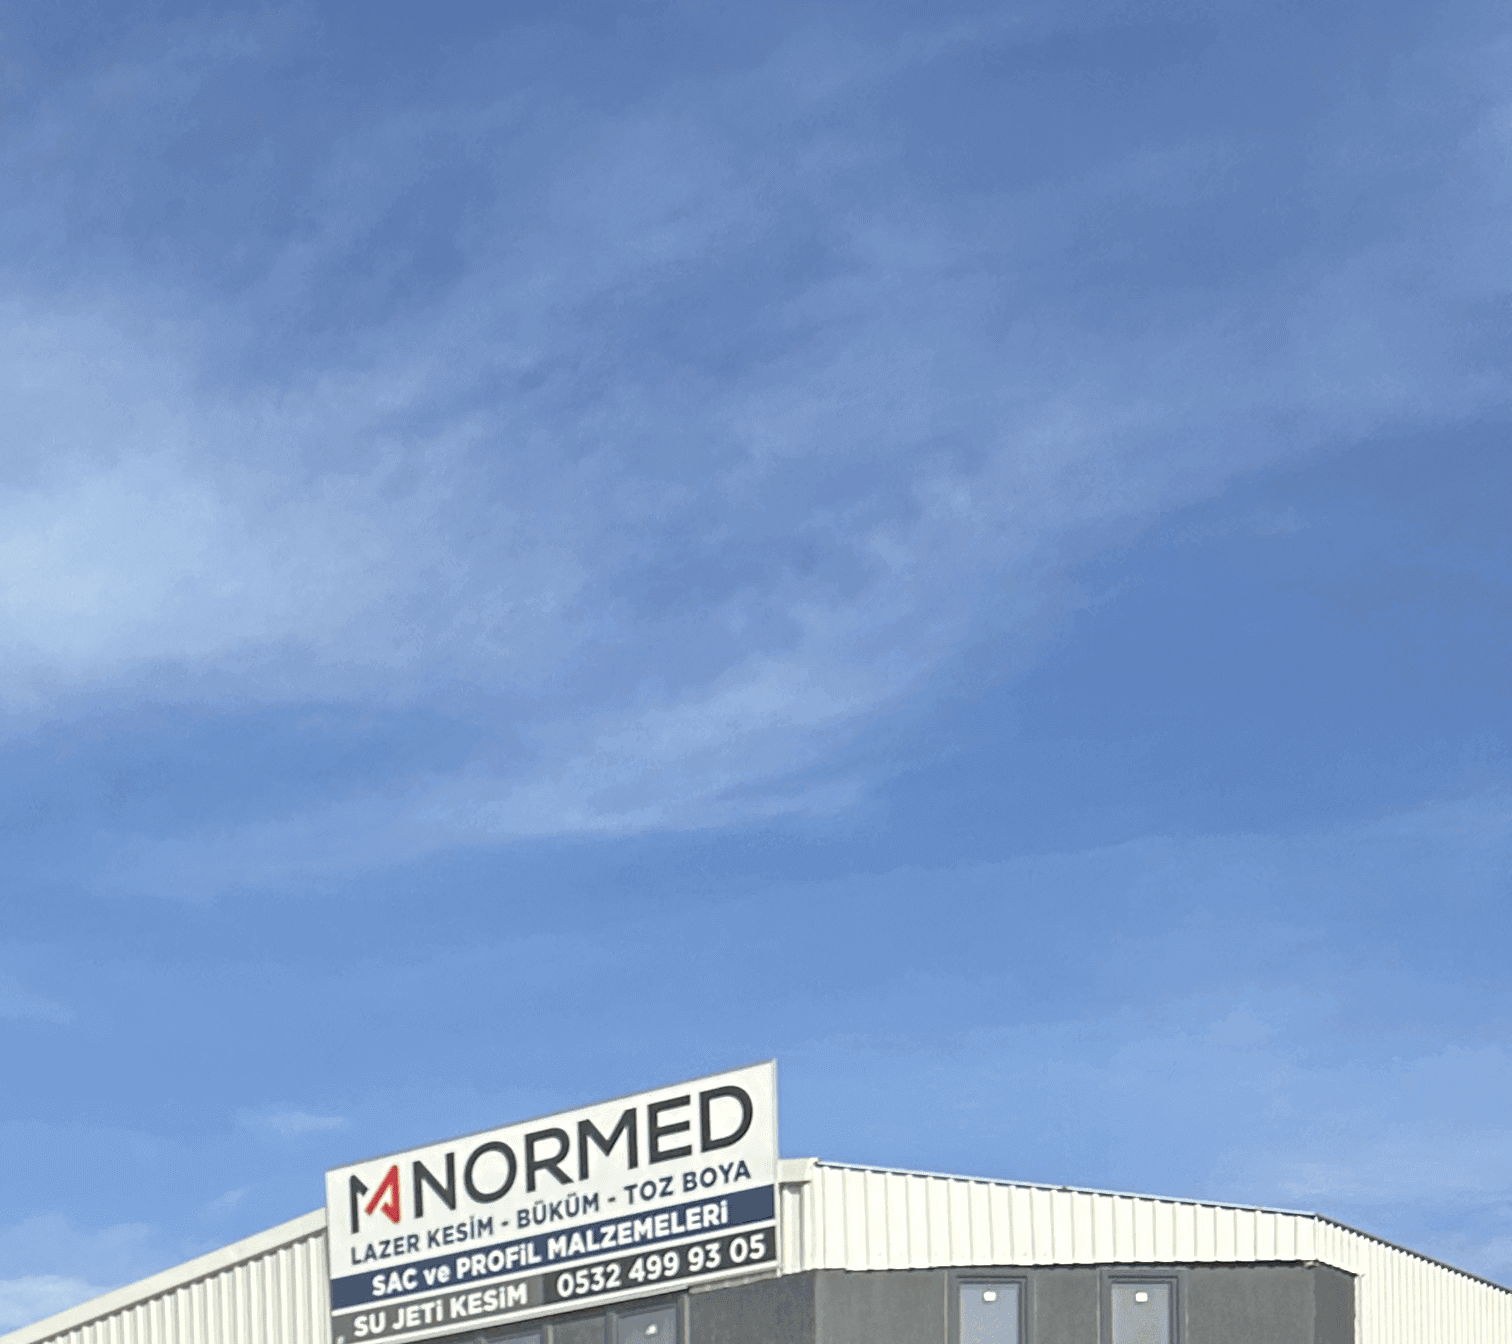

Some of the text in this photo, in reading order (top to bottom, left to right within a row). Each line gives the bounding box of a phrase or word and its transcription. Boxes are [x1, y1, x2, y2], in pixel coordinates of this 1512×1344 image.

[351, 1234, 419, 1265] LAZER
[517, 1192, 599, 1230] BÜKÜM
[624, 1176, 673, 1205] TOZ
[682, 1160, 751, 1193] BOYA
[354, 1312, 386, 1337] SU
[557, 1264, 622, 1298] 0532
[628, 1251, 680, 1282] 499
[688, 1243, 721, 1272] 93
[729, 1233, 765, 1263] 05
[372, 1268, 418, 1296] SAC
[423, 1265, 451, 1285] ve
